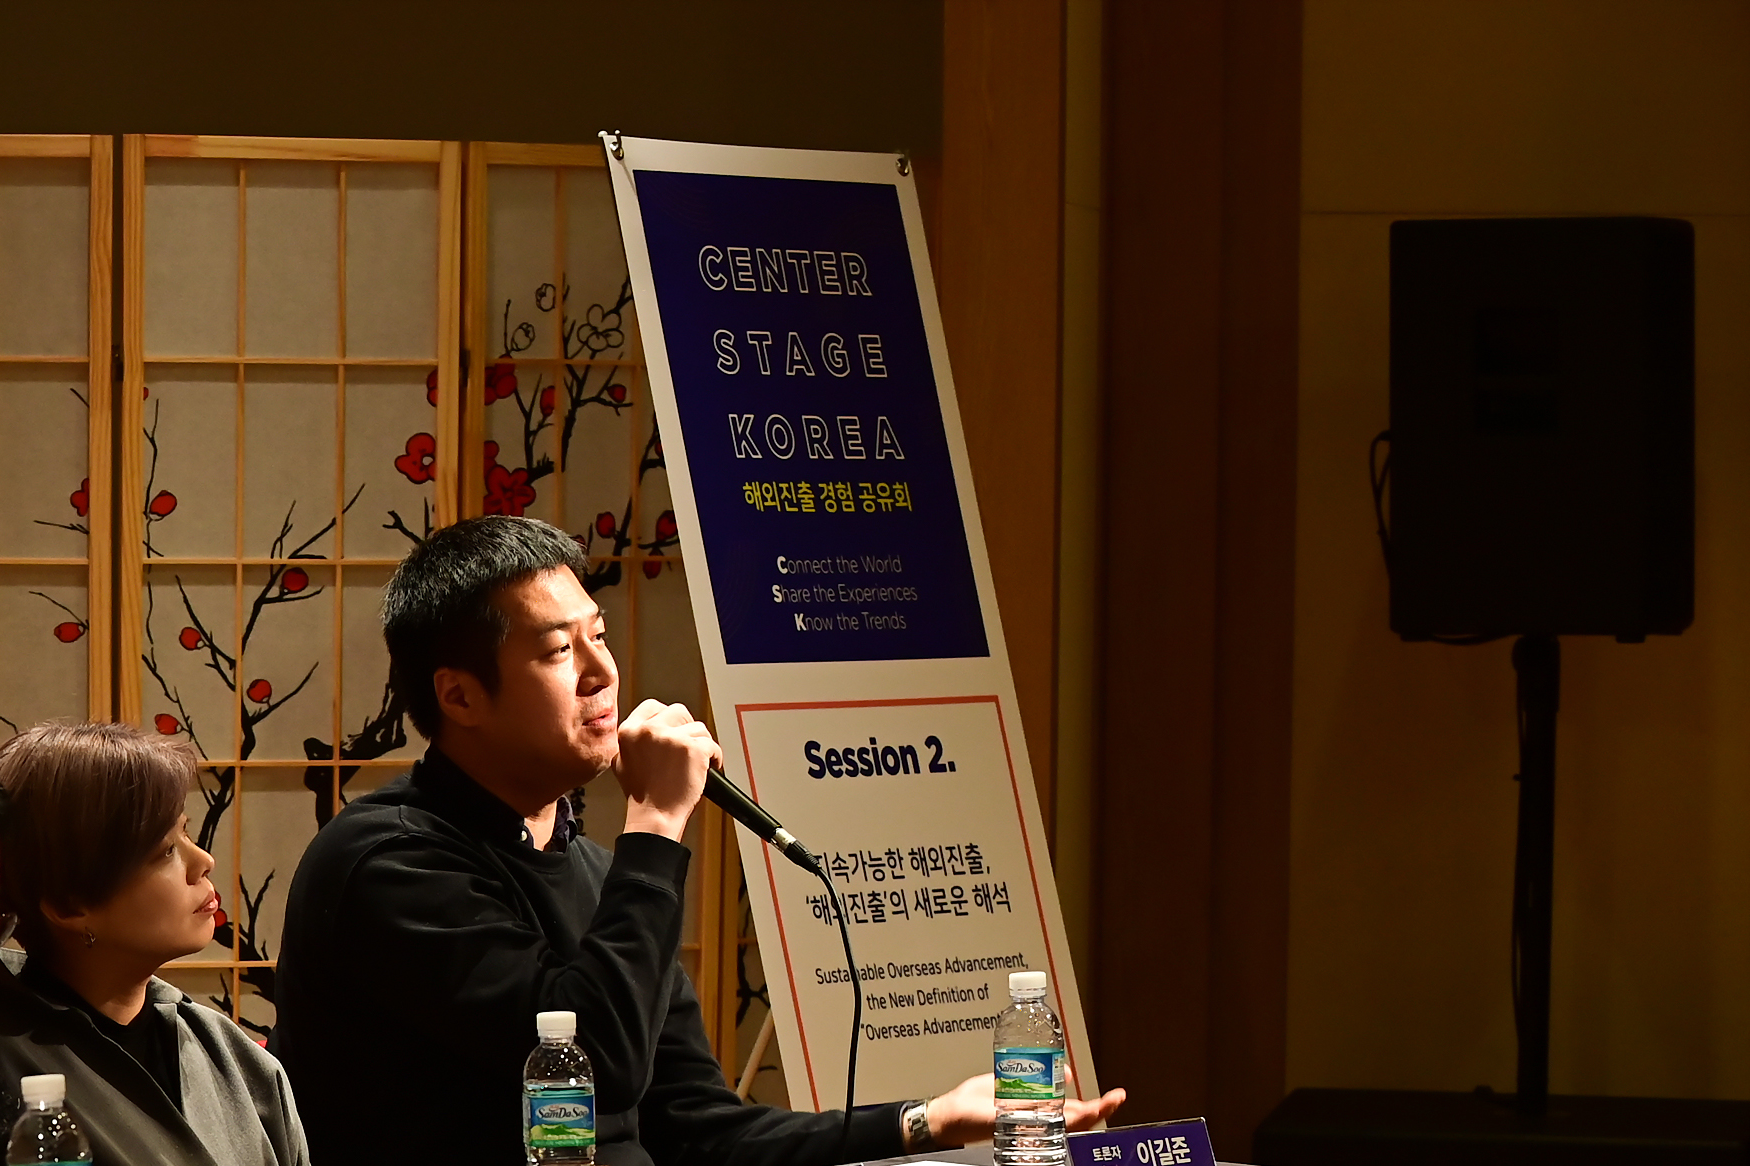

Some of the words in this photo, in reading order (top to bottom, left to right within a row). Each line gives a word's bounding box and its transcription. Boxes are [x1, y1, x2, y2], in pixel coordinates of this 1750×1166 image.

[699, 245, 872, 297] CENTER
[713, 329, 887, 377] STAGE
[728, 414, 905, 460] KOREA
[742, 481, 816, 512] 해외진출
[818, 481, 856, 513] 경험
[858, 481, 913, 513] 공유회
[777, 555, 834, 574] Connect
[836, 555, 859, 574] the
[860, 554, 902, 574] World
[772, 584, 811, 603] Share
[813, 584, 836, 602] the
[837, 583, 918, 604] Experiences
[794, 613, 833, 631] Know
[836, 612, 859, 631] the
[861, 611, 907, 631] Trends
[804, 736, 921, 779] Session
[924, 735, 956, 774] 2.
[908, 842, 991, 878] 해외진출,
[914, 885, 969, 919] 새로운
[972, 881, 1011, 914] 해석
[815, 963, 885, 985] Sustaable
[887, 961, 942, 980] Overseas
[944, 952, 1029, 975] Advancement,
[866, 993, 887, 1010] the
[888, 991, 915, 1009] New
[917, 986, 975, 1006] Definition
[977, 983, 990, 1000] of
[997, 1062, 1044, 1074] SamDaSoo
[1092, 1145, 1122, 1162] 토론자
